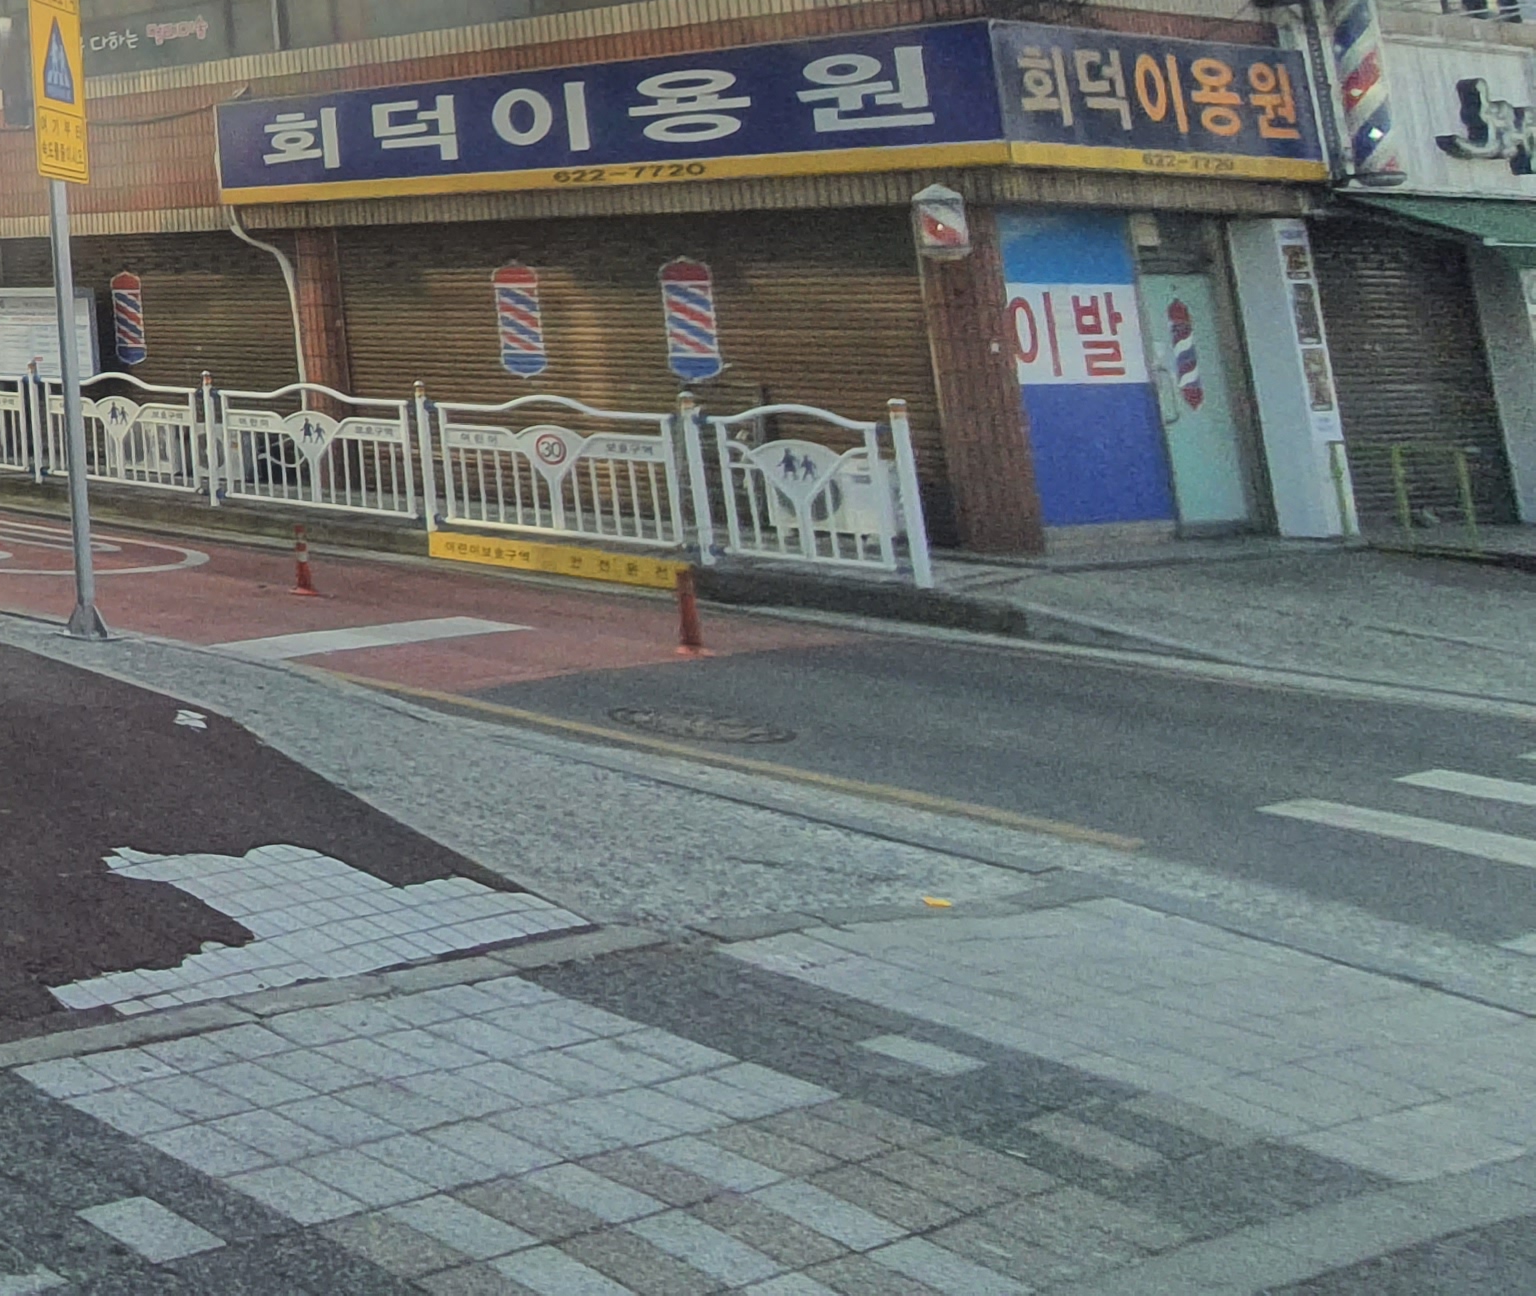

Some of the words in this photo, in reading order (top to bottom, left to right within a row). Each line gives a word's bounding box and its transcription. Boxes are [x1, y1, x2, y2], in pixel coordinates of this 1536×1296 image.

[89, 28, 140, 51] 다하는
[261, 44, 936, 171] 회덕이용원
[1017, 45, 1301, 141] 회덕이용원
[552, 161, 706, 185] 622-7720
[1008, 291, 1126, 379] 이발
[540, 440, 562, 459] 30
